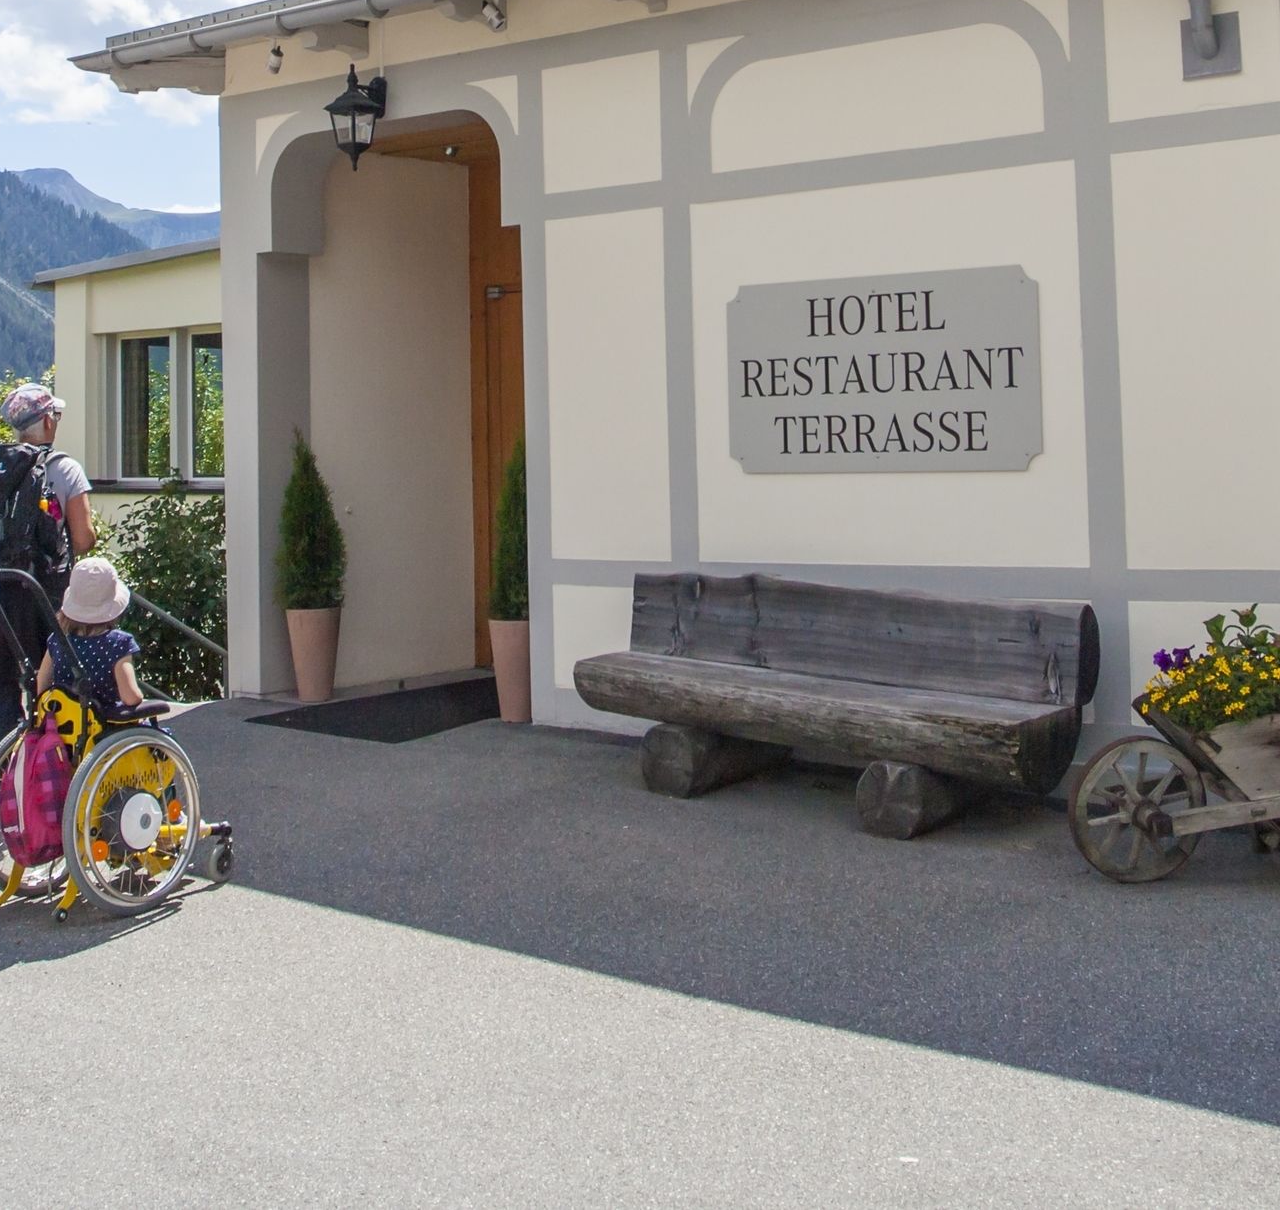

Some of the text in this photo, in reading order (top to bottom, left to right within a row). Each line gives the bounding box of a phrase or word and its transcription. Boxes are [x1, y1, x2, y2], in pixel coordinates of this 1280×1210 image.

[806, 290, 946, 338] HOTEL
[740, 346, 1024, 398] RESTAURANT
[773, 410, 989, 455] TERRASSE
